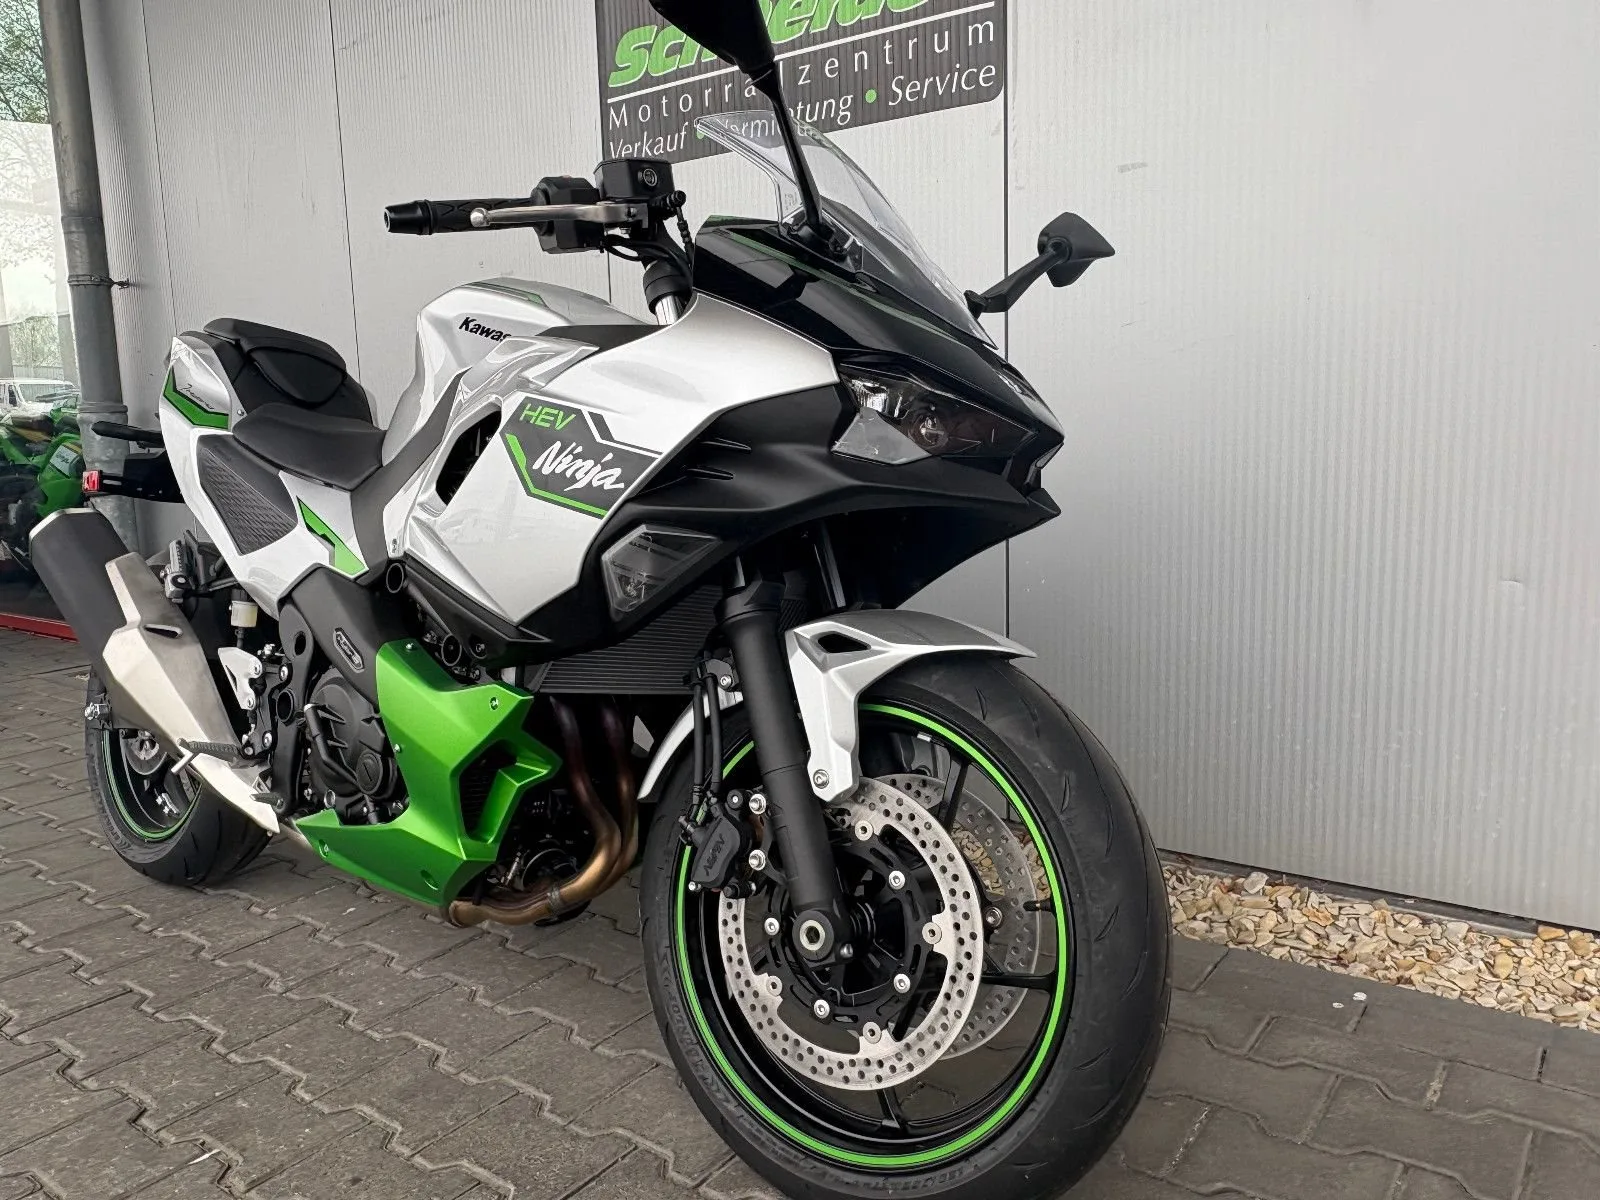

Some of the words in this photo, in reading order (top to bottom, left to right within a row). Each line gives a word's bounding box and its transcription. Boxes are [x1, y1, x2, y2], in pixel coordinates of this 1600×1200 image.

[609, 122, 689, 159] Verkauf
[888, 63, 996, 106] Service
[519, 403, 577, 431] HEV
[532, 441, 625, 491] Ninja
